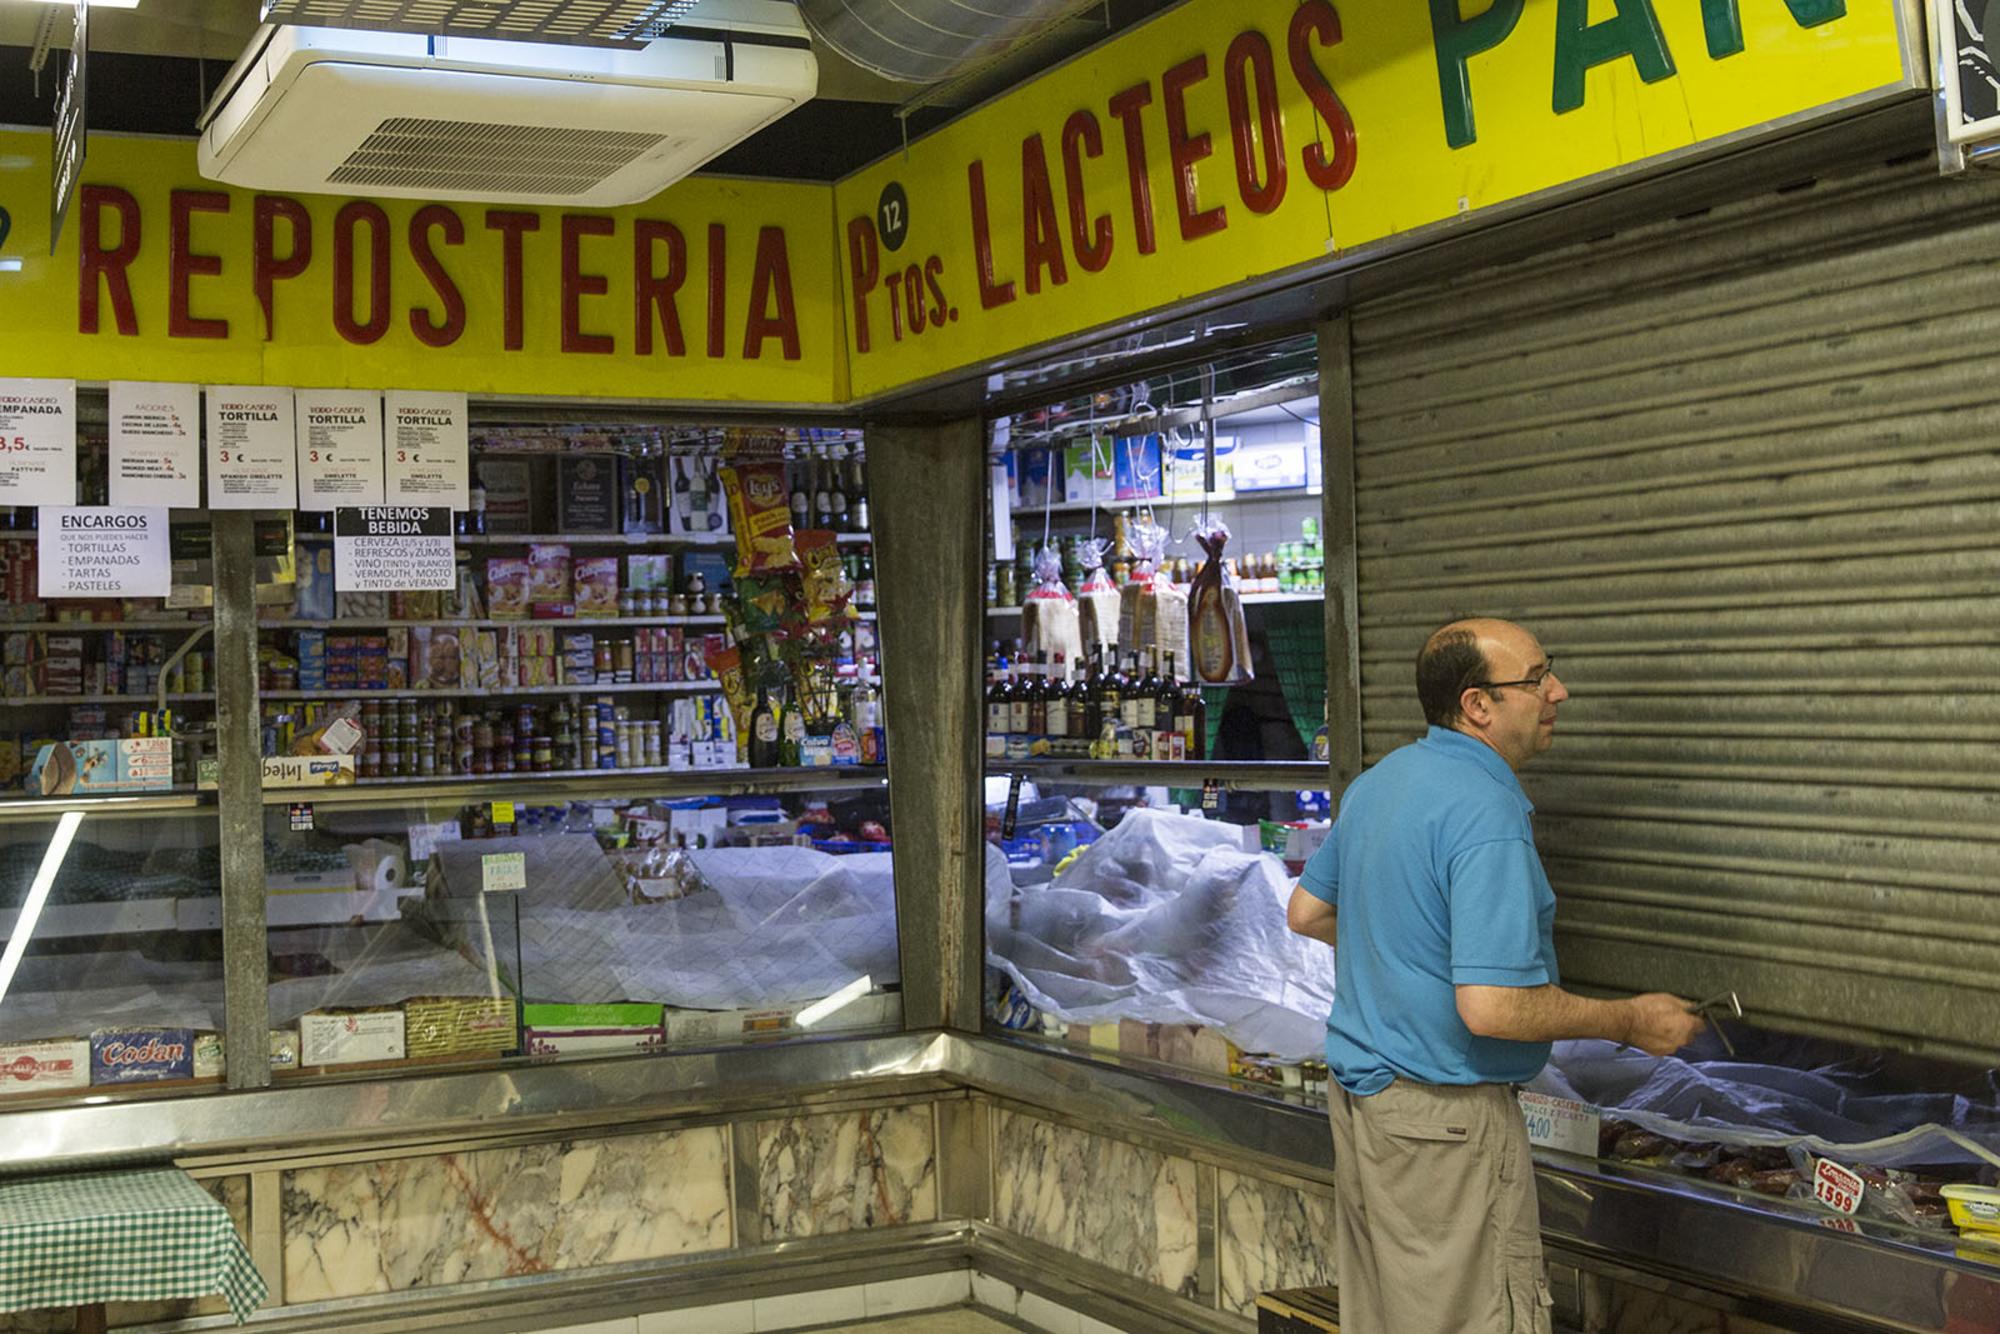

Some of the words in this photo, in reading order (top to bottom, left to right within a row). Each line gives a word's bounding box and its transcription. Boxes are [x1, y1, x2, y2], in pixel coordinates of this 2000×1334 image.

[968, 0, 1358, 310] LACTEOS
[883, 199, 903, 234] 12
[78, 184, 802, 361] REPOSTERIA
[221, 403, 243, 411] TODO
[310, 406, 332, 414] TODO
[333, 406, 366, 414] CASERO
[398, 407, 420, 415] TODO
[421, 408, 453, 416] CASERO
[218, 411, 278, 421] TORTILLA
[308, 415, 367, 424] TORTILLA
[396, 416, 453, 426] TORTILLA
[219, 450, 230, 463] 3
[309, 450, 319, 463] 3
[397, 450, 406, 463] 3
[358, 507, 430, 521] TENEMOS
[61, 515, 148, 529] ENCARGOS
[368, 521, 422, 534] BEBIDA
[77, 533, 94, 541] NOS
[353, 538, 400, 547] CERVEZA
[68, 543, 126, 553] TORTILLAS
[354, 548, 408, 558] REFRESCOS
[415, 548, 451, 558] ZUMOS
[68, 555, 140, 566] EMPANADAS
[355, 559, 381, 568] VINO
[68, 568, 111, 578] TARTAS
[415, 569, 452, 578] MOSTO
[68, 580, 121, 591] PASTELES
[363, 579, 392, 588] TINTO
[393, 579, 406, 588] de
[408, 578, 449, 588] VERANO
[101, 1038, 186, 1067] Codan
[1816, 1180, 1854, 1214] 1599
